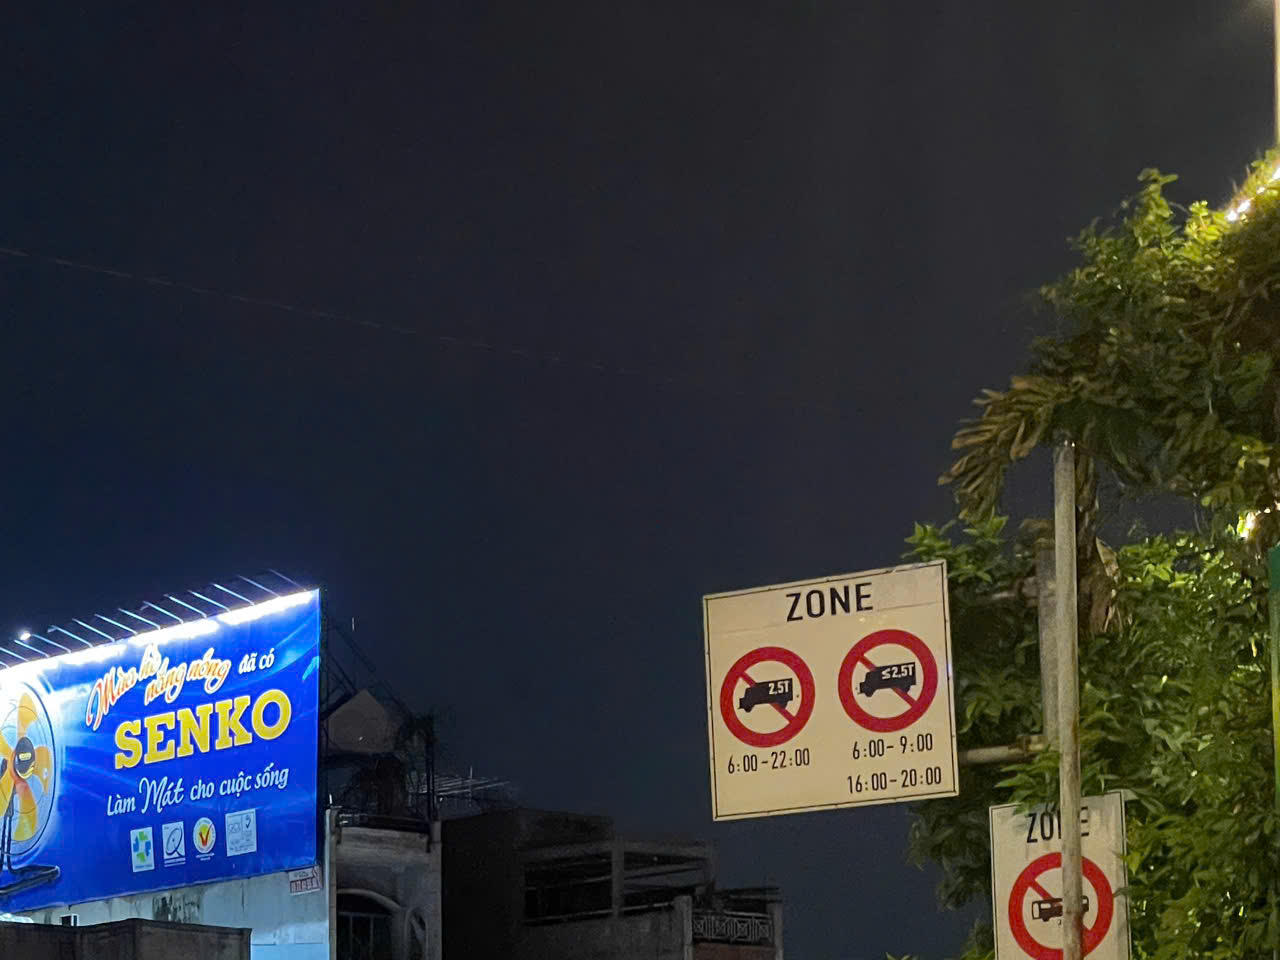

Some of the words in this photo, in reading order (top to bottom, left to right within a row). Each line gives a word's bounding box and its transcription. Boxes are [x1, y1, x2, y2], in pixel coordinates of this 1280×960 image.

[786, 582, 874, 622] ZONE
[238, 652, 258, 675] đã
[258, 647, 275, 670] có
[768, 679, 790, 696] 2.5T
[114, 688, 293, 770] SENKO
[107, 794, 137, 816] Làm
[138, 776, 185, 814] Mát
[189, 779, 215, 801] cho
[219, 771, 252, 797] cuộc
[254, 762, 290, 789] sống
[1026, 807, 1090, 843] ZOE
